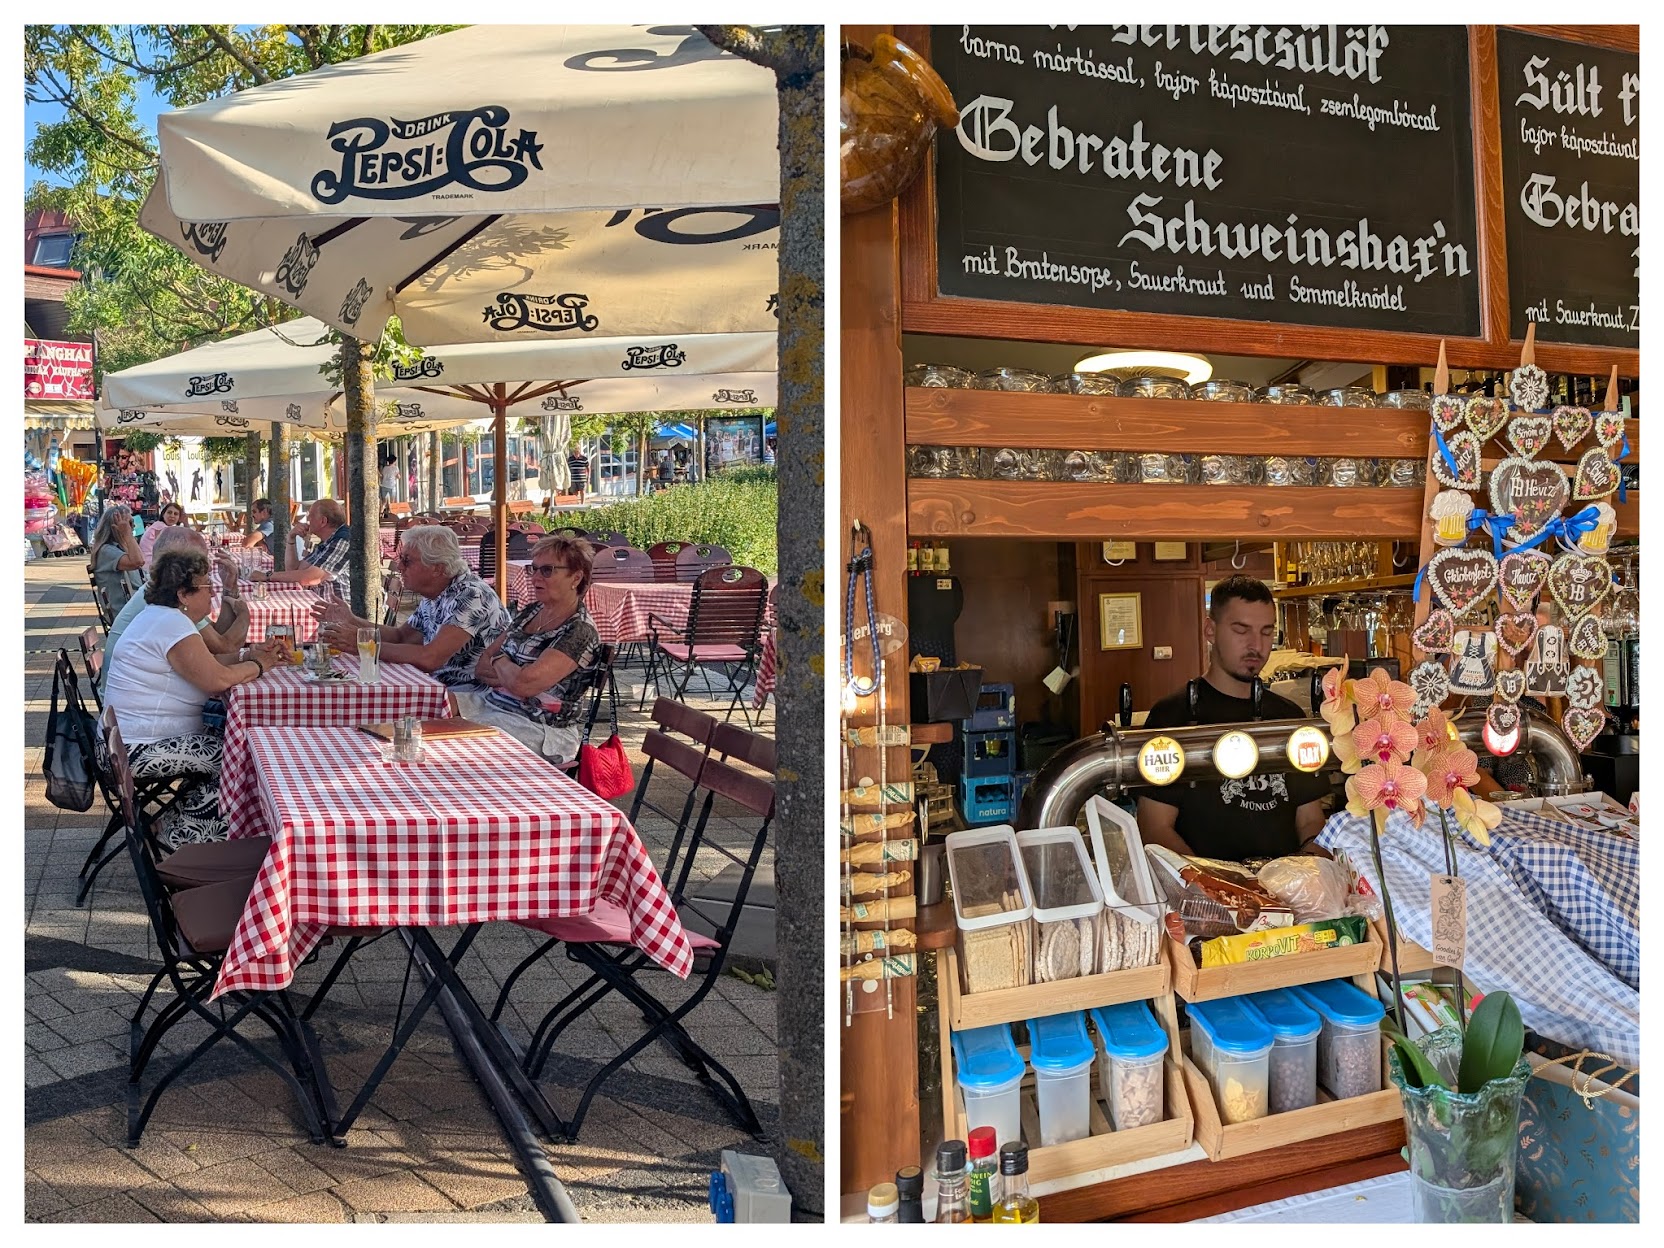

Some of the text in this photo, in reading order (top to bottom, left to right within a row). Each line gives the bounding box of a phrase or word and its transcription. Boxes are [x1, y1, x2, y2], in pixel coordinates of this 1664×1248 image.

[960, 25, 1440, 131] barna mártással, bajor káposztával, zsemlegombóccal
[1515, 54, 1603, 118] Sült
[404, 114, 451, 137] DRINK
[1521, 117, 1557, 154] bajor
[956, 94, 1223, 190] Gebratene
[1520, 172, 1639, 236] Gebra
[1117, 192, 1471, 282] Schweinshax'n
[962, 246, 999, 276] mit
[1127, 262, 1227, 297] Sauerkraut
[1241, 275, 1275, 301] und
[1289, 280, 1407, 312] Semmelknödel
[1525, 298, 1551, 324] mit
[25, 345, 92, 362] HANGHAI
[1510, 477, 1556, 498] HB Hévíz
[1570, 583, 1585, 601] HB
[1144, 752, 1180, 767] HAUS
[978, 807, 1007, 817] natura
[971, 1171, 992, 1179] WEIN
